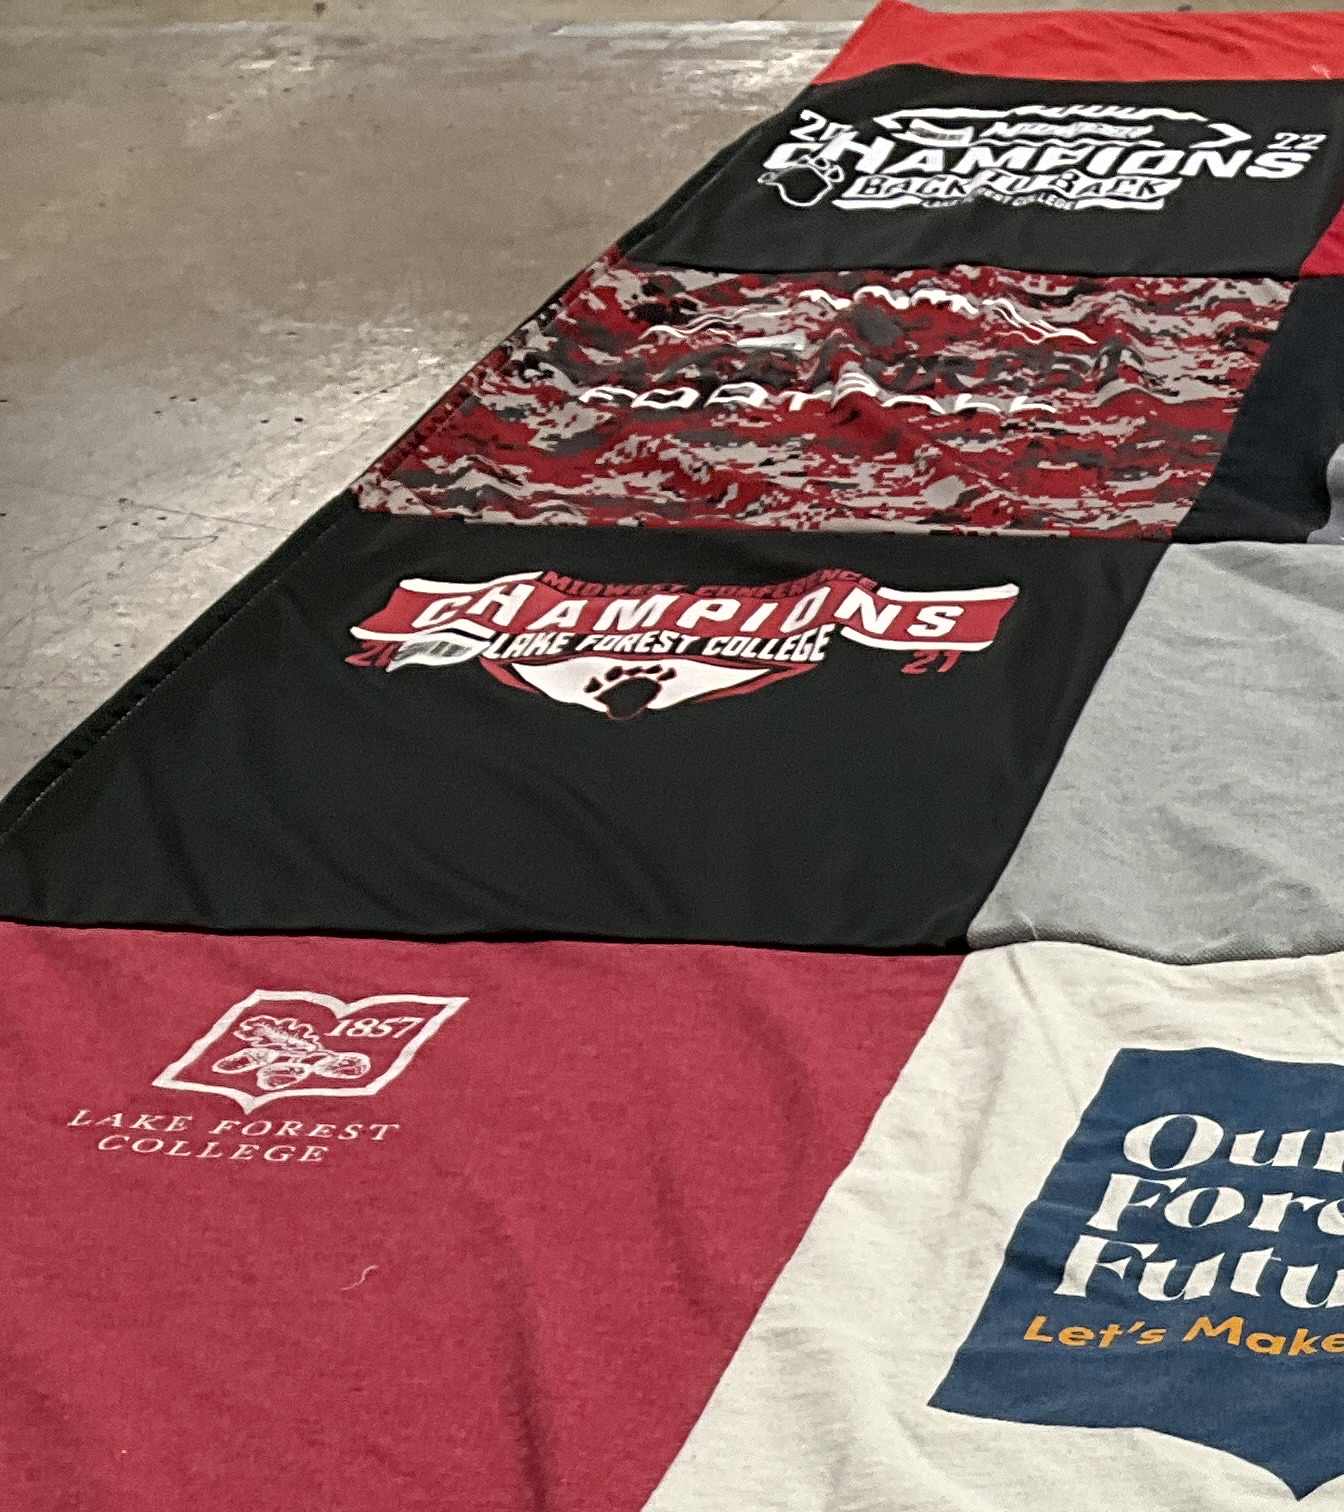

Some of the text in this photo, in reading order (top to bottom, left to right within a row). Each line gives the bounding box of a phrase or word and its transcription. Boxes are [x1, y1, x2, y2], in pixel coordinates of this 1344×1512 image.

[763, 131, 1312, 179] CHAMPIONS
[1267, 131, 1327, 150] 22
[1050, 172, 1169, 198] BACK
[411, 582, 965, 638] CHAMPIONS
[482, 623, 837, 662] LAKE FOREST COLLEGE
[323, 1015, 425, 1041] 1857
[66, 1108, 401, 1142] LAKE FOREST
[96, 1133, 331, 1163] COLLEGE
[1023, 1314, 1166, 1348] Let's
